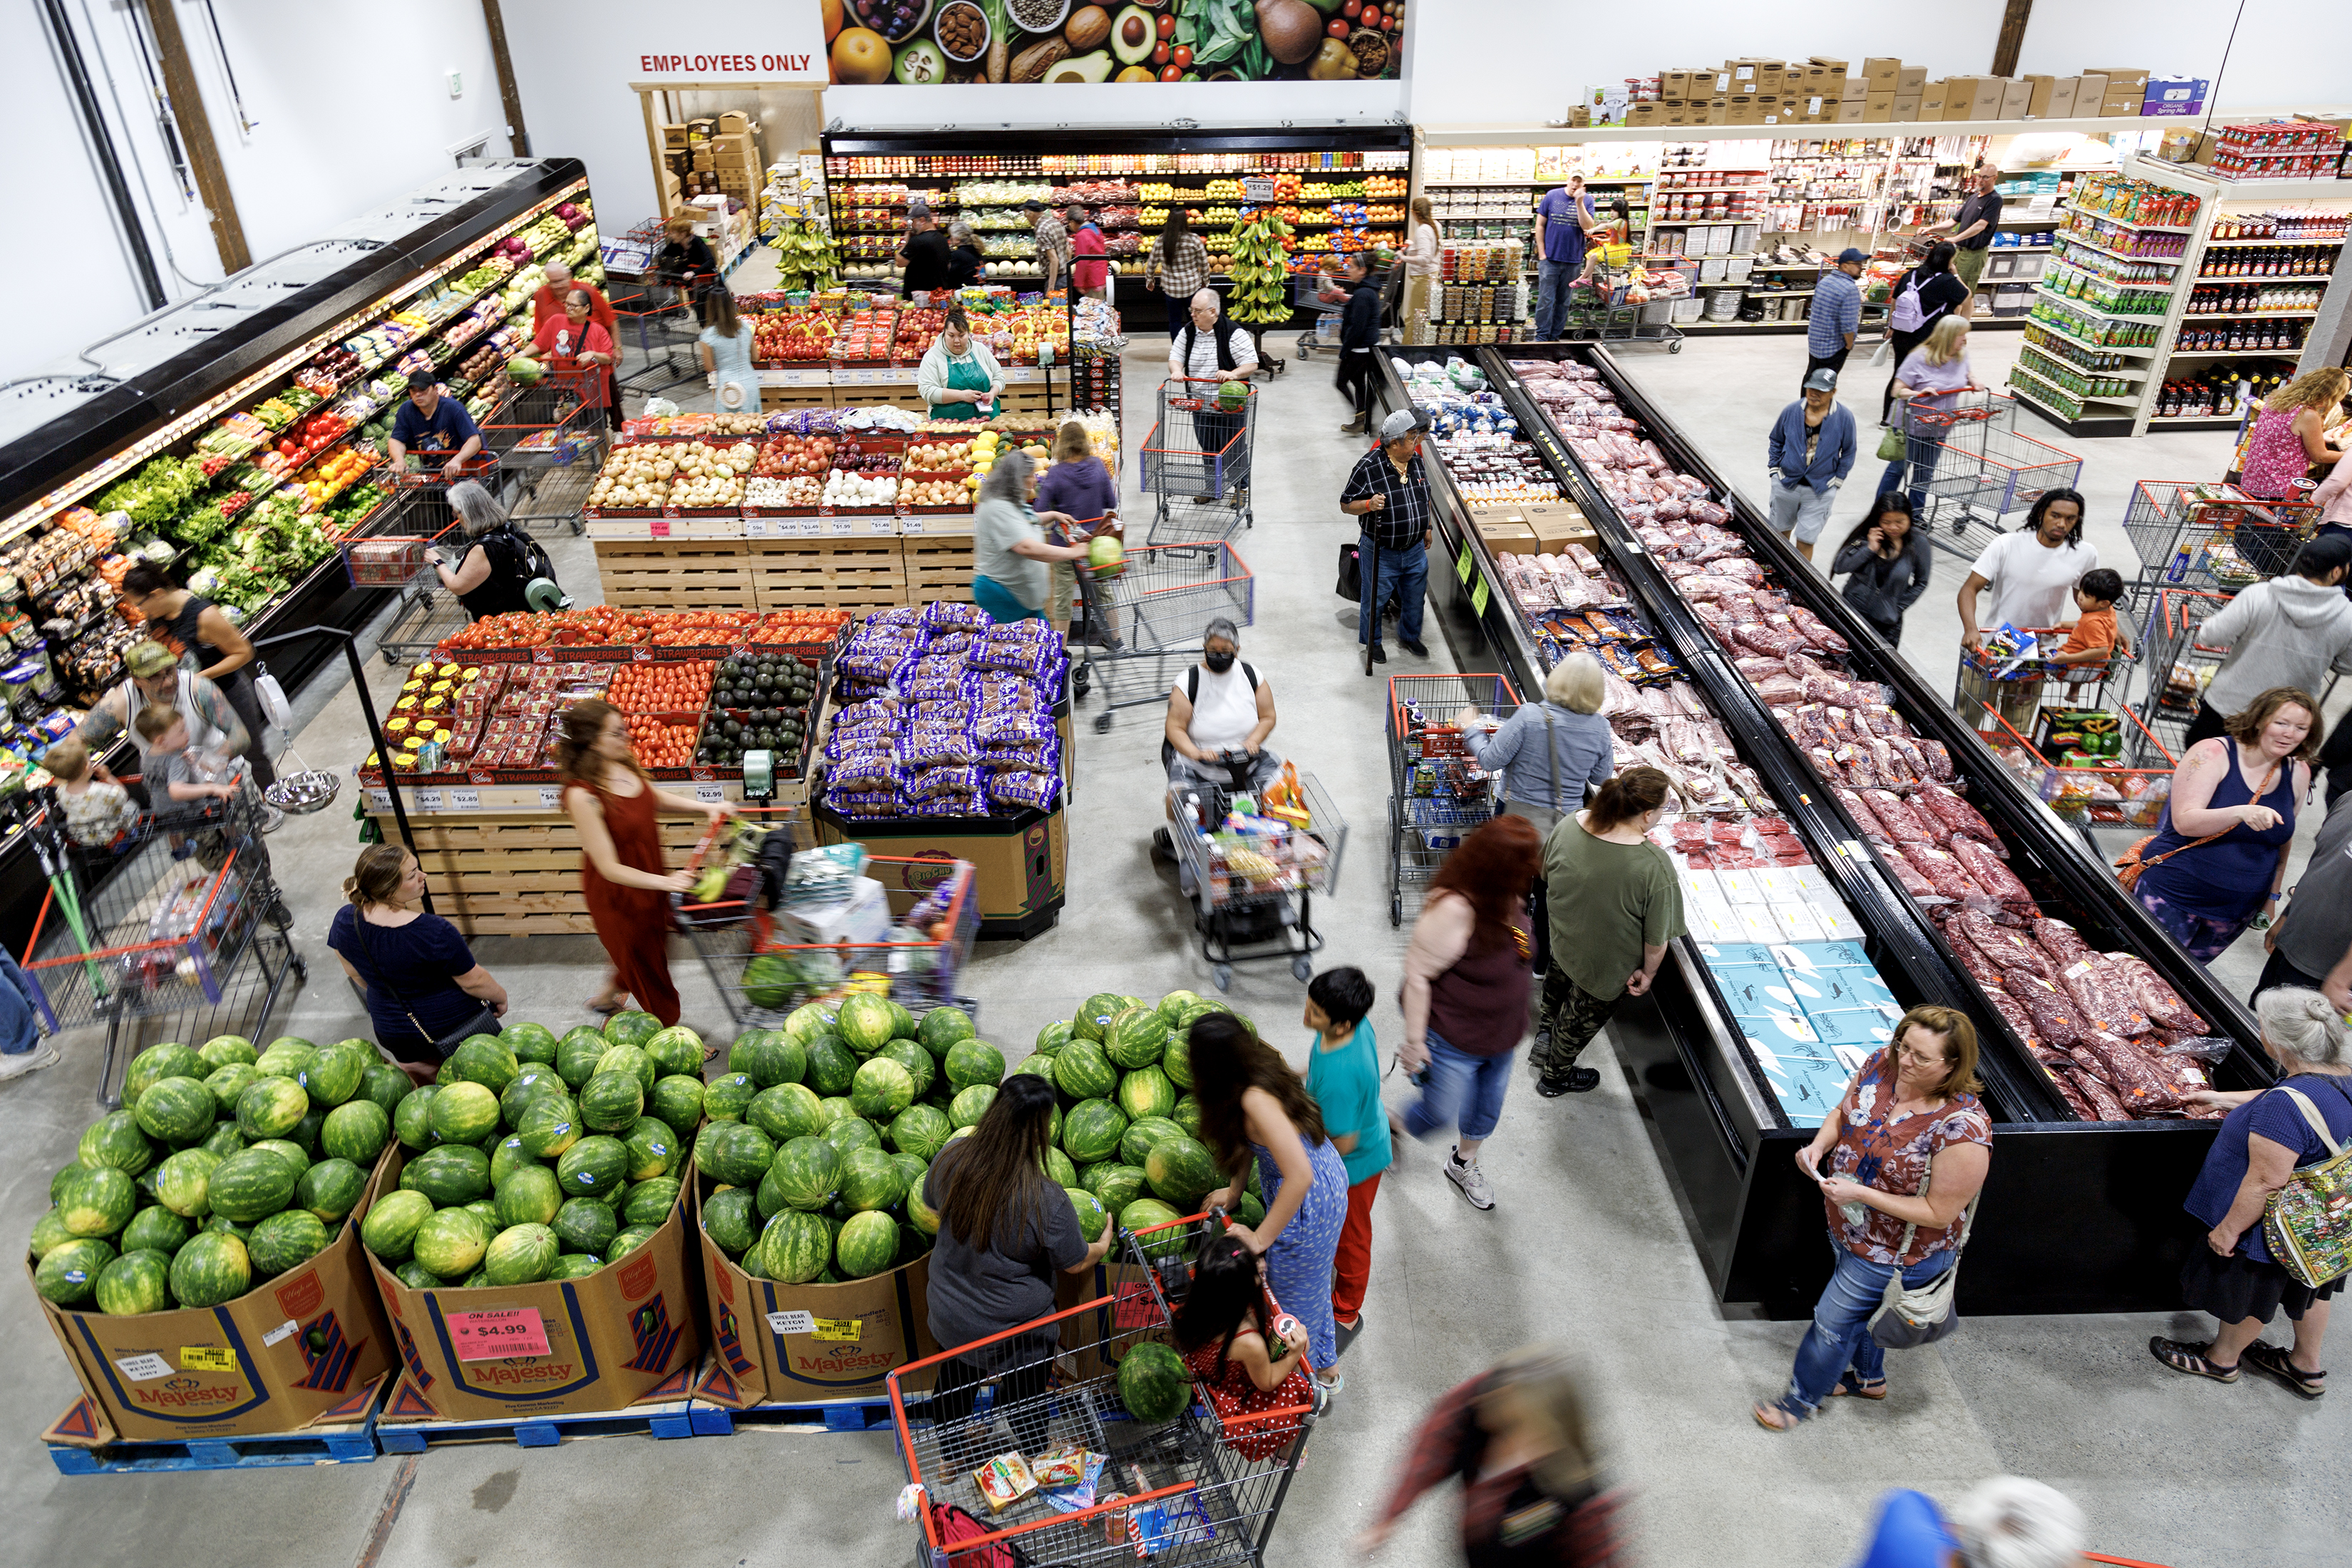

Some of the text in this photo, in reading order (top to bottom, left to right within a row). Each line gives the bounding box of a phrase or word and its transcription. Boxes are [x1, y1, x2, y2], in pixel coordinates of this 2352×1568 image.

[641, 54, 811, 72] EMPLOYEES ONLY
[601, 509, 659, 517] STRAWBERRIES
[681, 509, 738, 517] STRAWBERRIES
[760, 508, 817, 517] STRAWBERRIES
[835, 507, 893, 515] STRAWBERRIES
[455, 651, 529, 663] STRAWBERRIES
[557, 649, 630, 661] STRAWBERRIES
[656, 647, 728, 659] STRAWBERRIES
[993, 656, 1028, 669] HUSKY
[854, 667, 884, 678] HUSKY
[994, 751, 1032, 761] HUSKY
[845, 766, 883, 778] HUSKY
[395, 775, 467, 786] TRAWBERRIES
[924, 771, 958, 788] HUSKY
[850, 793, 887, 802] HUSKY
[999, 787, 1033, 799] HUSKY
[925, 803, 964, 814] HUSKY
[1835, 968, 1850, 988] AZIMUTH
[1802, 1069, 1816, 1090] AZIMUTH
[855, 1308, 886, 1319] Seedless
[478, 1324, 527, 1337] $4.99
[129, 1363, 158, 1373] KETCH
[798, 1351, 895, 1374] Majesty
[472, 1363, 573, 1386] Majesty
[135, 1386, 239, 1408] Majesty
